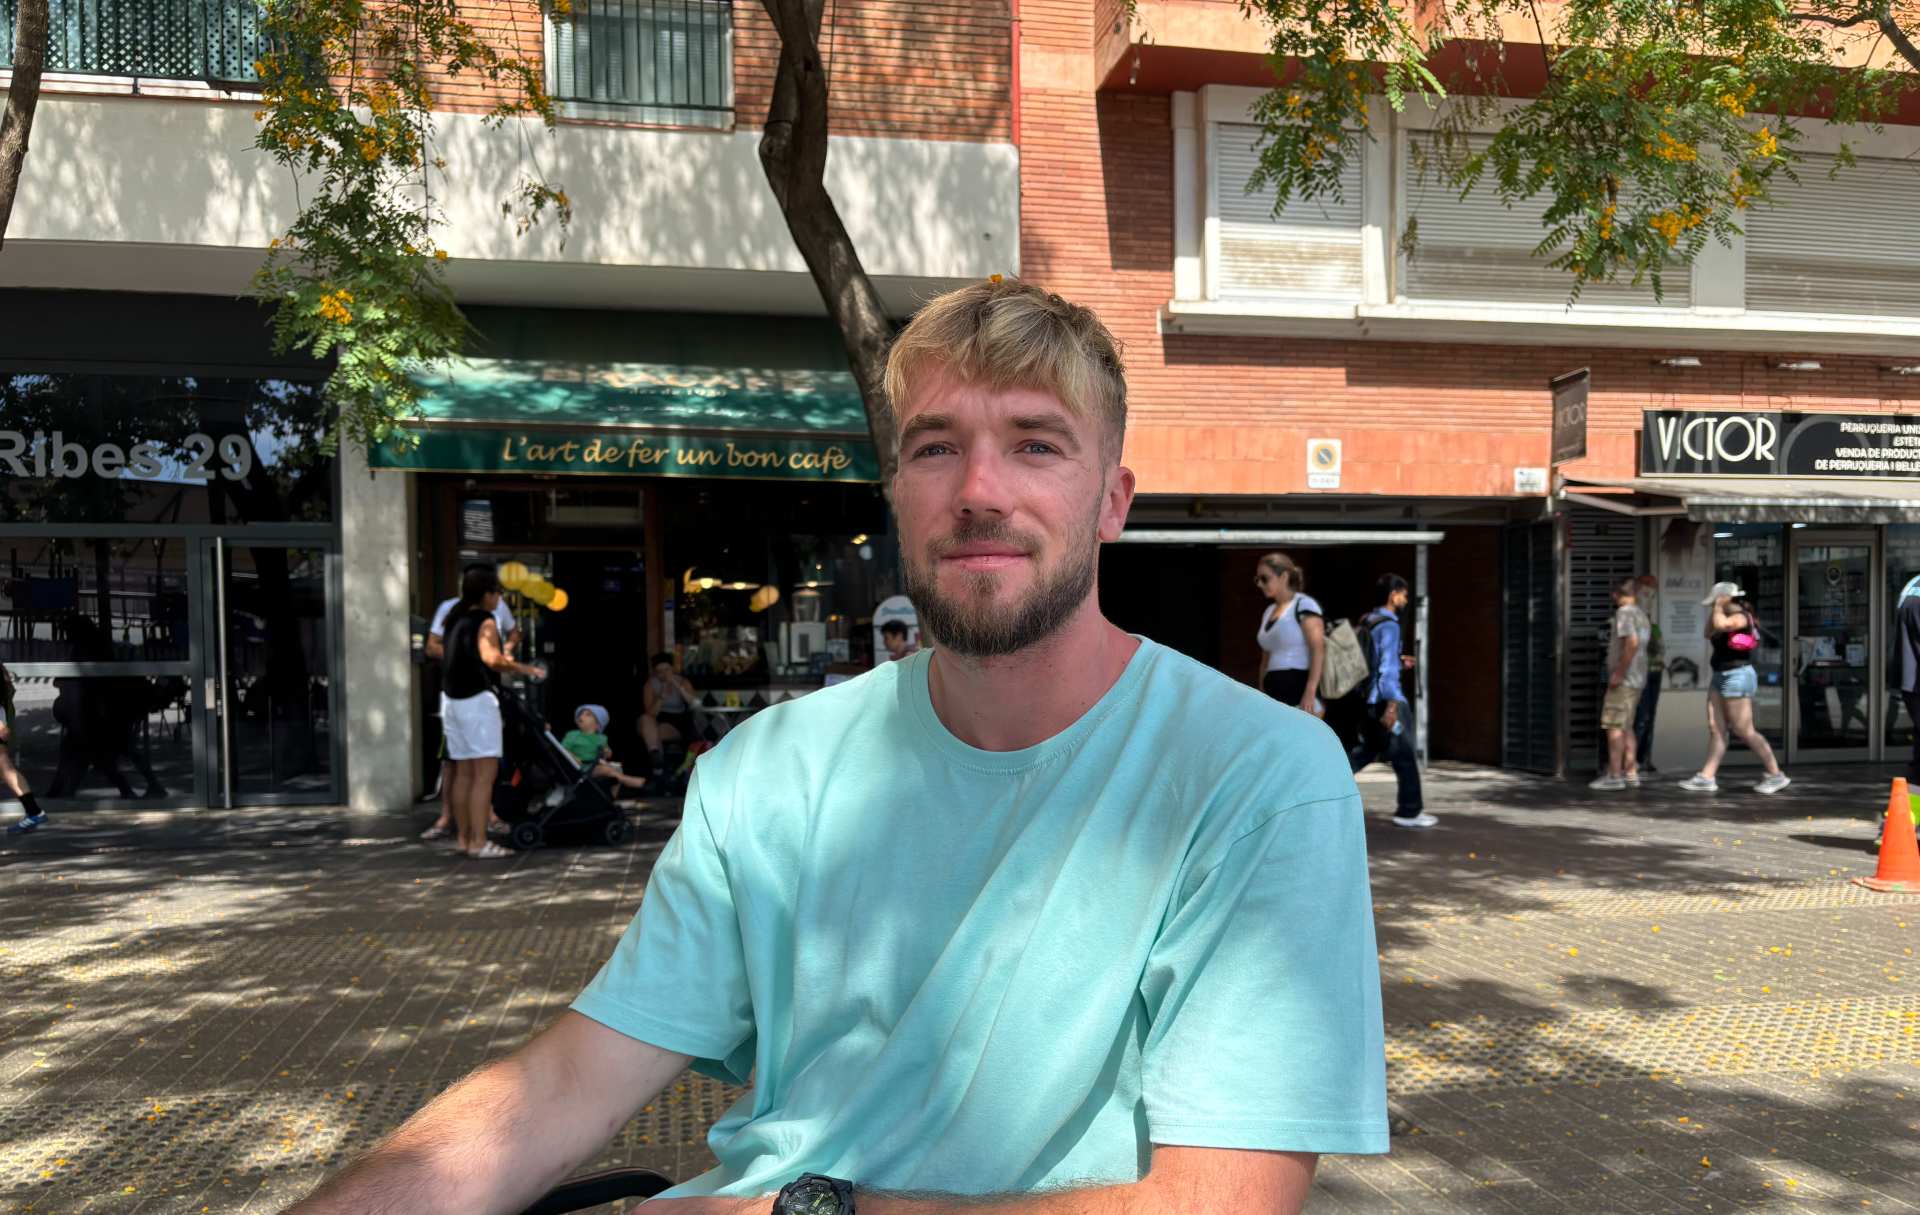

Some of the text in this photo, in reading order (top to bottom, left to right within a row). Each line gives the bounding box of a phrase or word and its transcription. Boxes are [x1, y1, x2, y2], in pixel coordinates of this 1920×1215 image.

[1658, 416, 1777, 462] VICTOR
[1840, 422, 1901, 434] PERRUQUERIA
[0, 430, 252, 481] Ribes 29
[502, 436, 580, 462] L'art
[583, 438, 625, 463] de
[627, 438, 670, 468] fer
[676, 448, 722, 465] un
[725, 442, 785, 468] bon
[1835, 447, 1867, 458] VENDA
[1868, 448, 1880, 458] DE
[1815, 459, 1828, 470] DE
[1829, 459, 1889, 472] PERRUQUERIA
